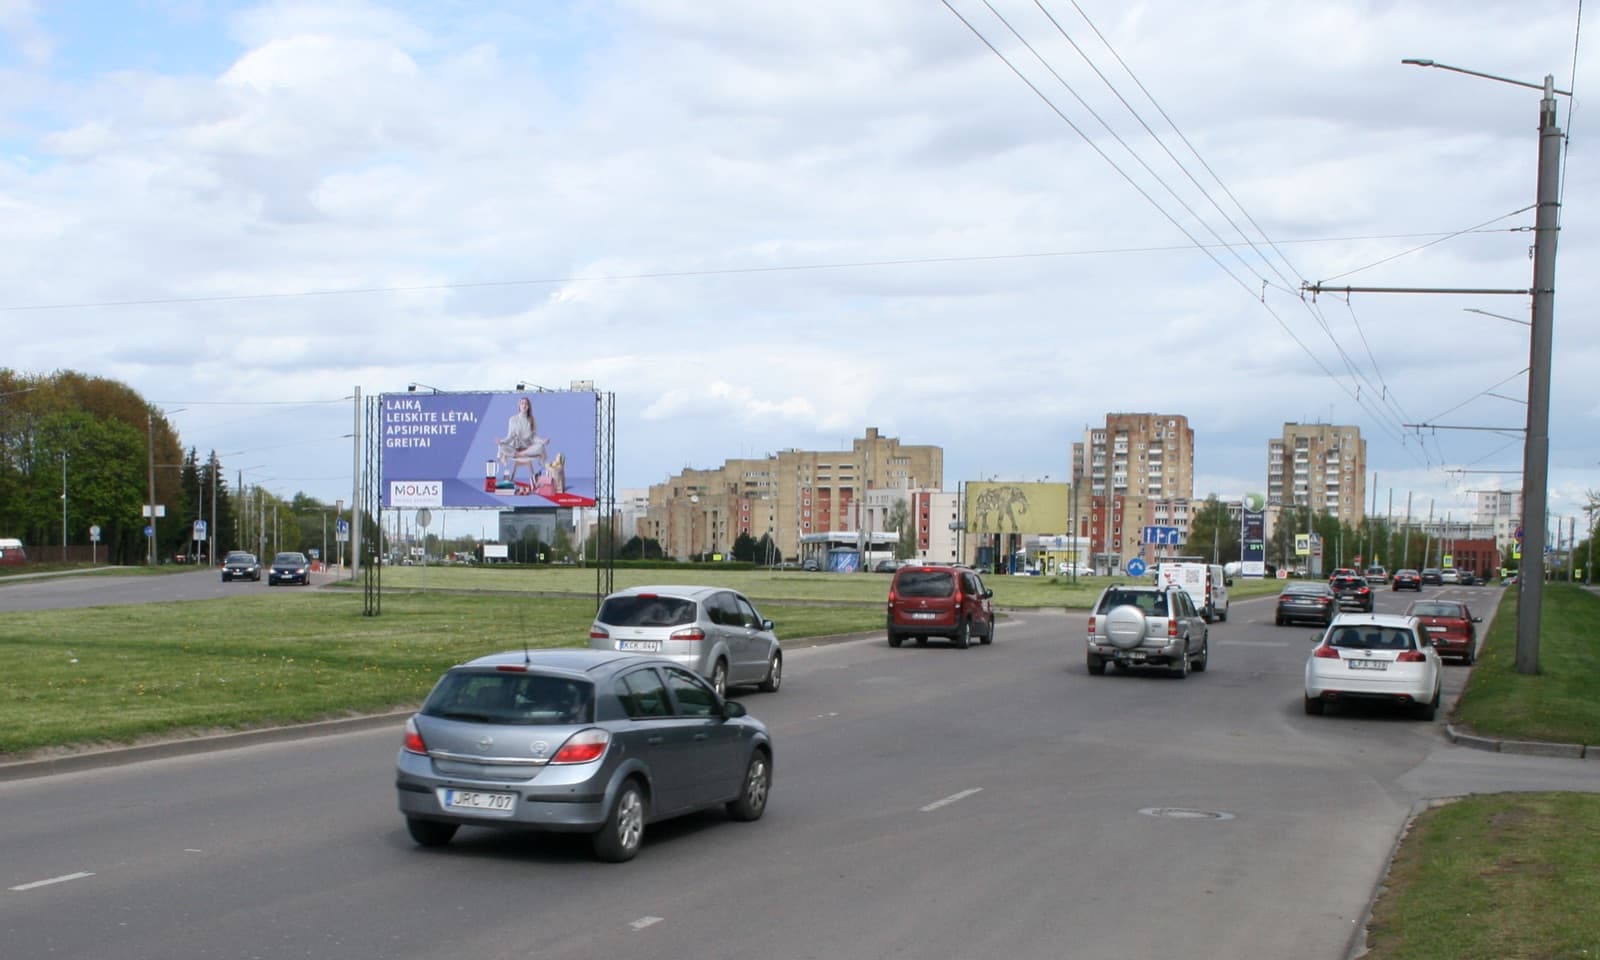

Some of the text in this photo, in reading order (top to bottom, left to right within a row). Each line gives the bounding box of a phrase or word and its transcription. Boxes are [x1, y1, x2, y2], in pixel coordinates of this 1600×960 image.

[386, 400, 421, 412] LAIKĄ
[386, 410, 478, 423] LEISKITE LĖTAI,
[386, 425, 457, 435] APSIPIRKITE
[386, 437, 431, 448] GREITAI
[394, 485, 439, 496] MOLAS
[454, 791, 512, 808] JRC 707
